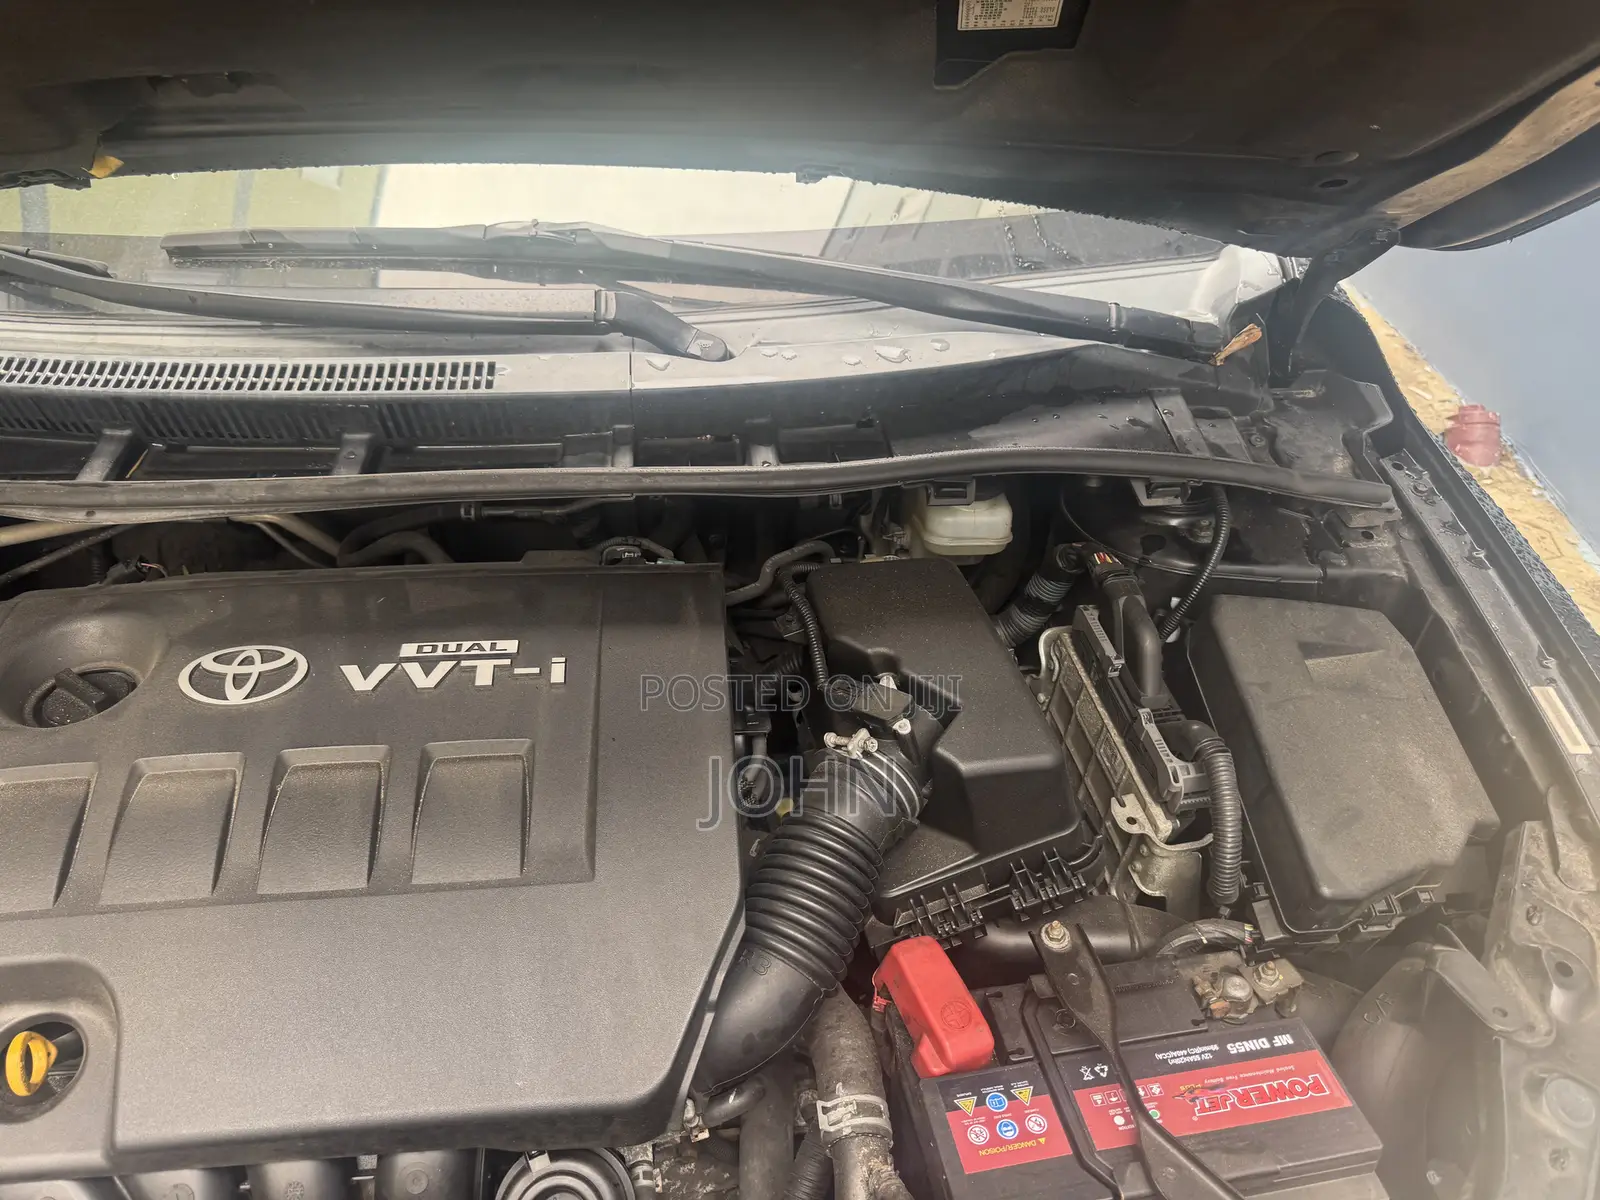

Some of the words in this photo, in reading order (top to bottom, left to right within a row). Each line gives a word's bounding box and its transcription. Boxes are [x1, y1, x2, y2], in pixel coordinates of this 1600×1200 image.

[415, 642, 507, 654] DUAL
[339, 656, 567, 691] VVT-i
[1226, 1037, 1270, 1054] DIN55
[1272, 1033, 1294, 1048] MF
[1200, 1053, 1213, 1061] 12V
[1243, 1068, 1277, 1078] Maintenance
[1229, 1074, 1330, 1109] POWER
[1195, 1093, 1235, 1116] JET
[978, 1140, 1037, 1157] DANGER/POISON
